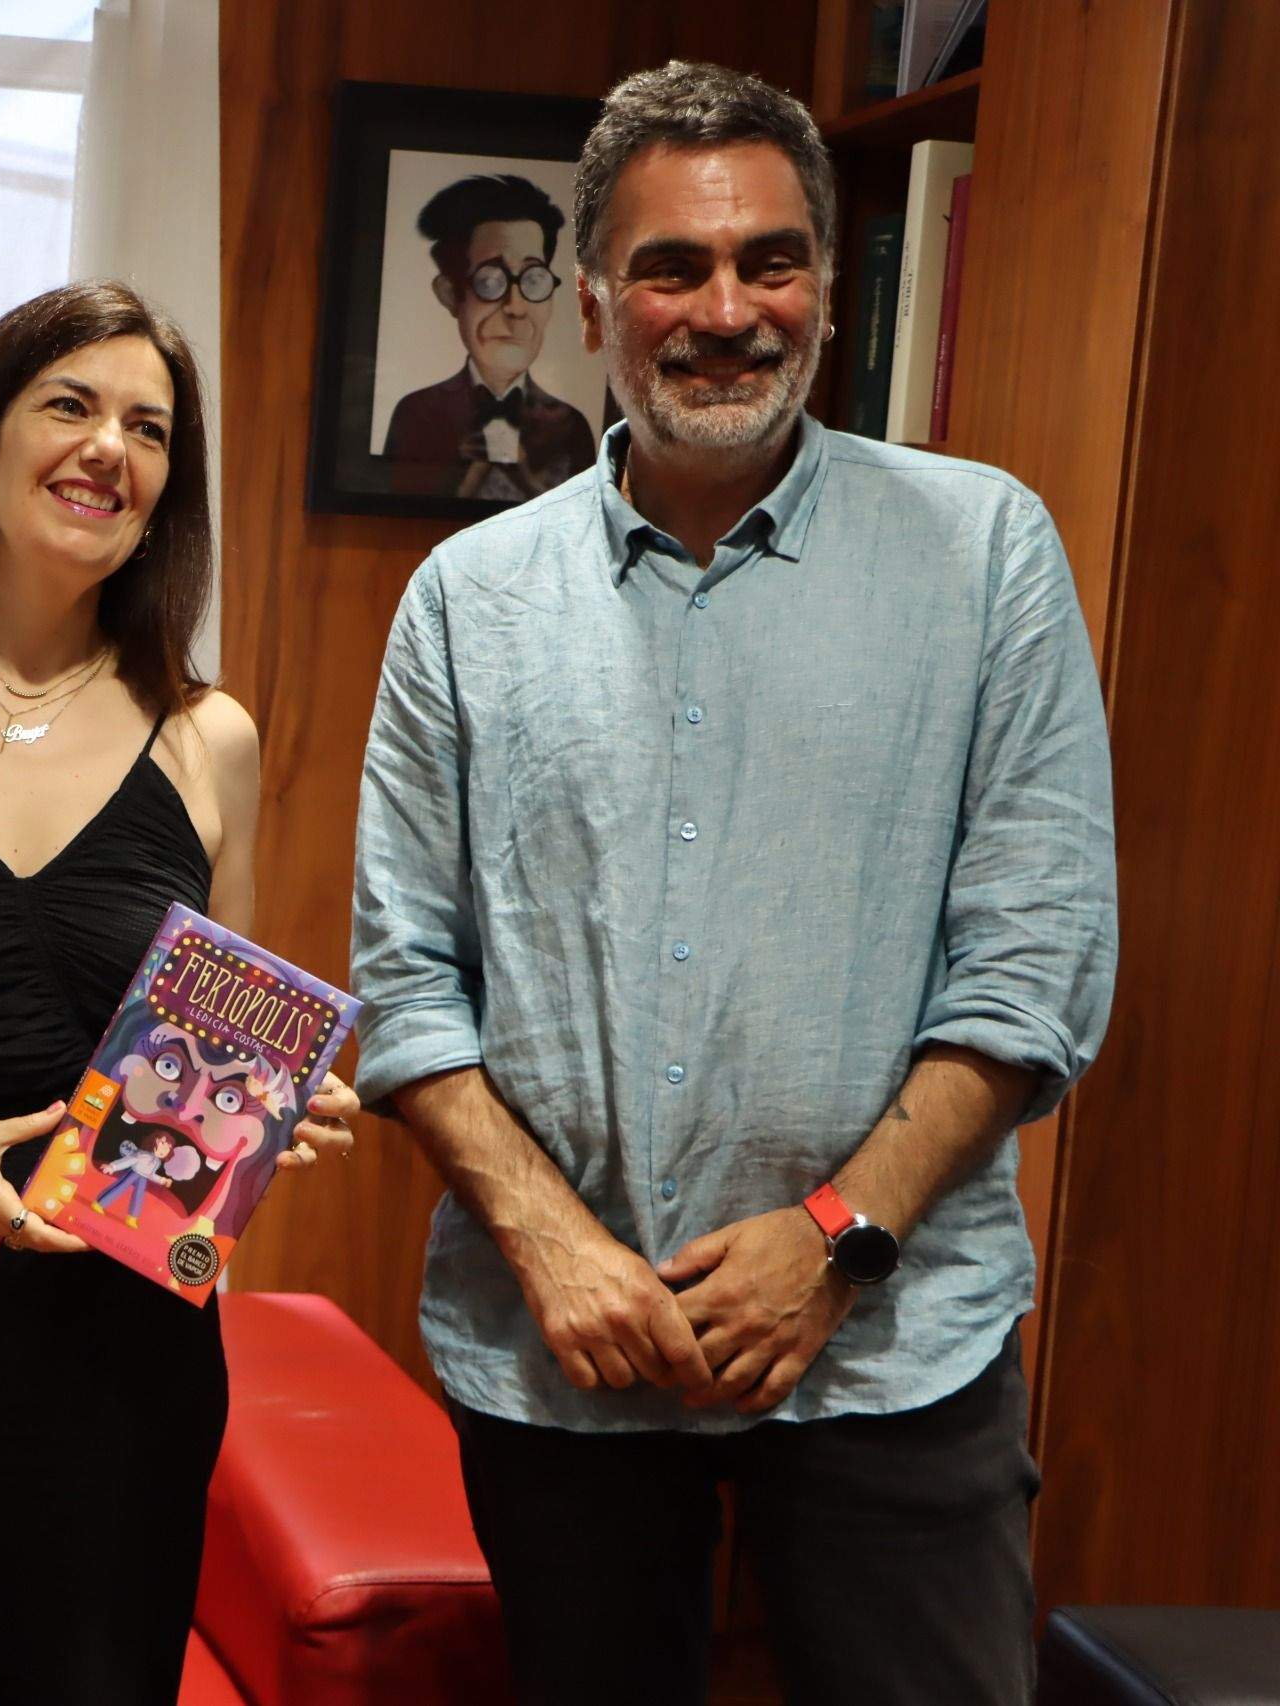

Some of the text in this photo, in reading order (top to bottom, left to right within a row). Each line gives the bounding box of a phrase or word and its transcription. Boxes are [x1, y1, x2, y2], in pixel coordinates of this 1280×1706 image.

[171, 952, 313, 1055] FERIÓPOLIS
[189, 1006, 267, 1054] LEDICIA COSTAS
[183, 1244, 210, 1264] PREMIO
[187, 1255, 207, 1270] BARCO
